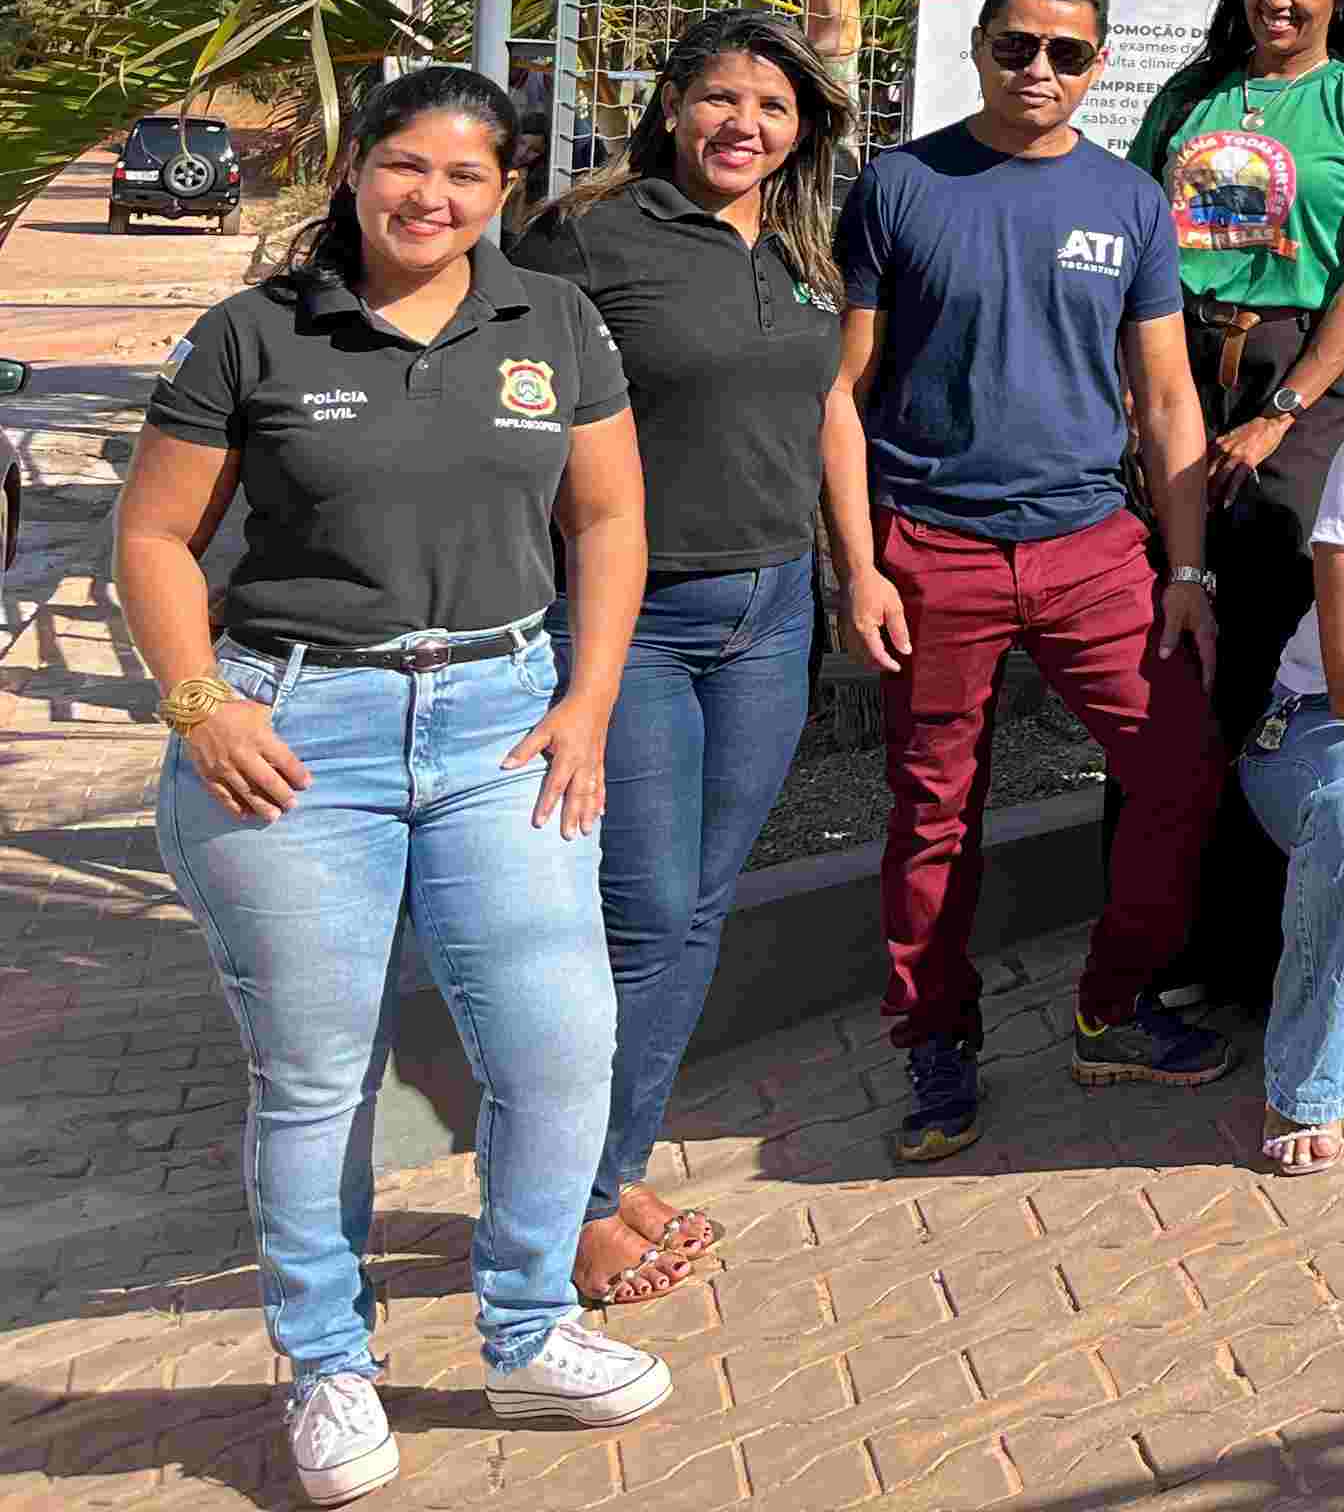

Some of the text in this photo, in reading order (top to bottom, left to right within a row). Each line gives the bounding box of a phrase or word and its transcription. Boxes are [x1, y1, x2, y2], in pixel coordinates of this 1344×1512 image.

[1060, 229, 1124, 267] ATI
[303, 389, 368, 405] POLÍCIA
[313, 408, 357, 421] CIVIL
